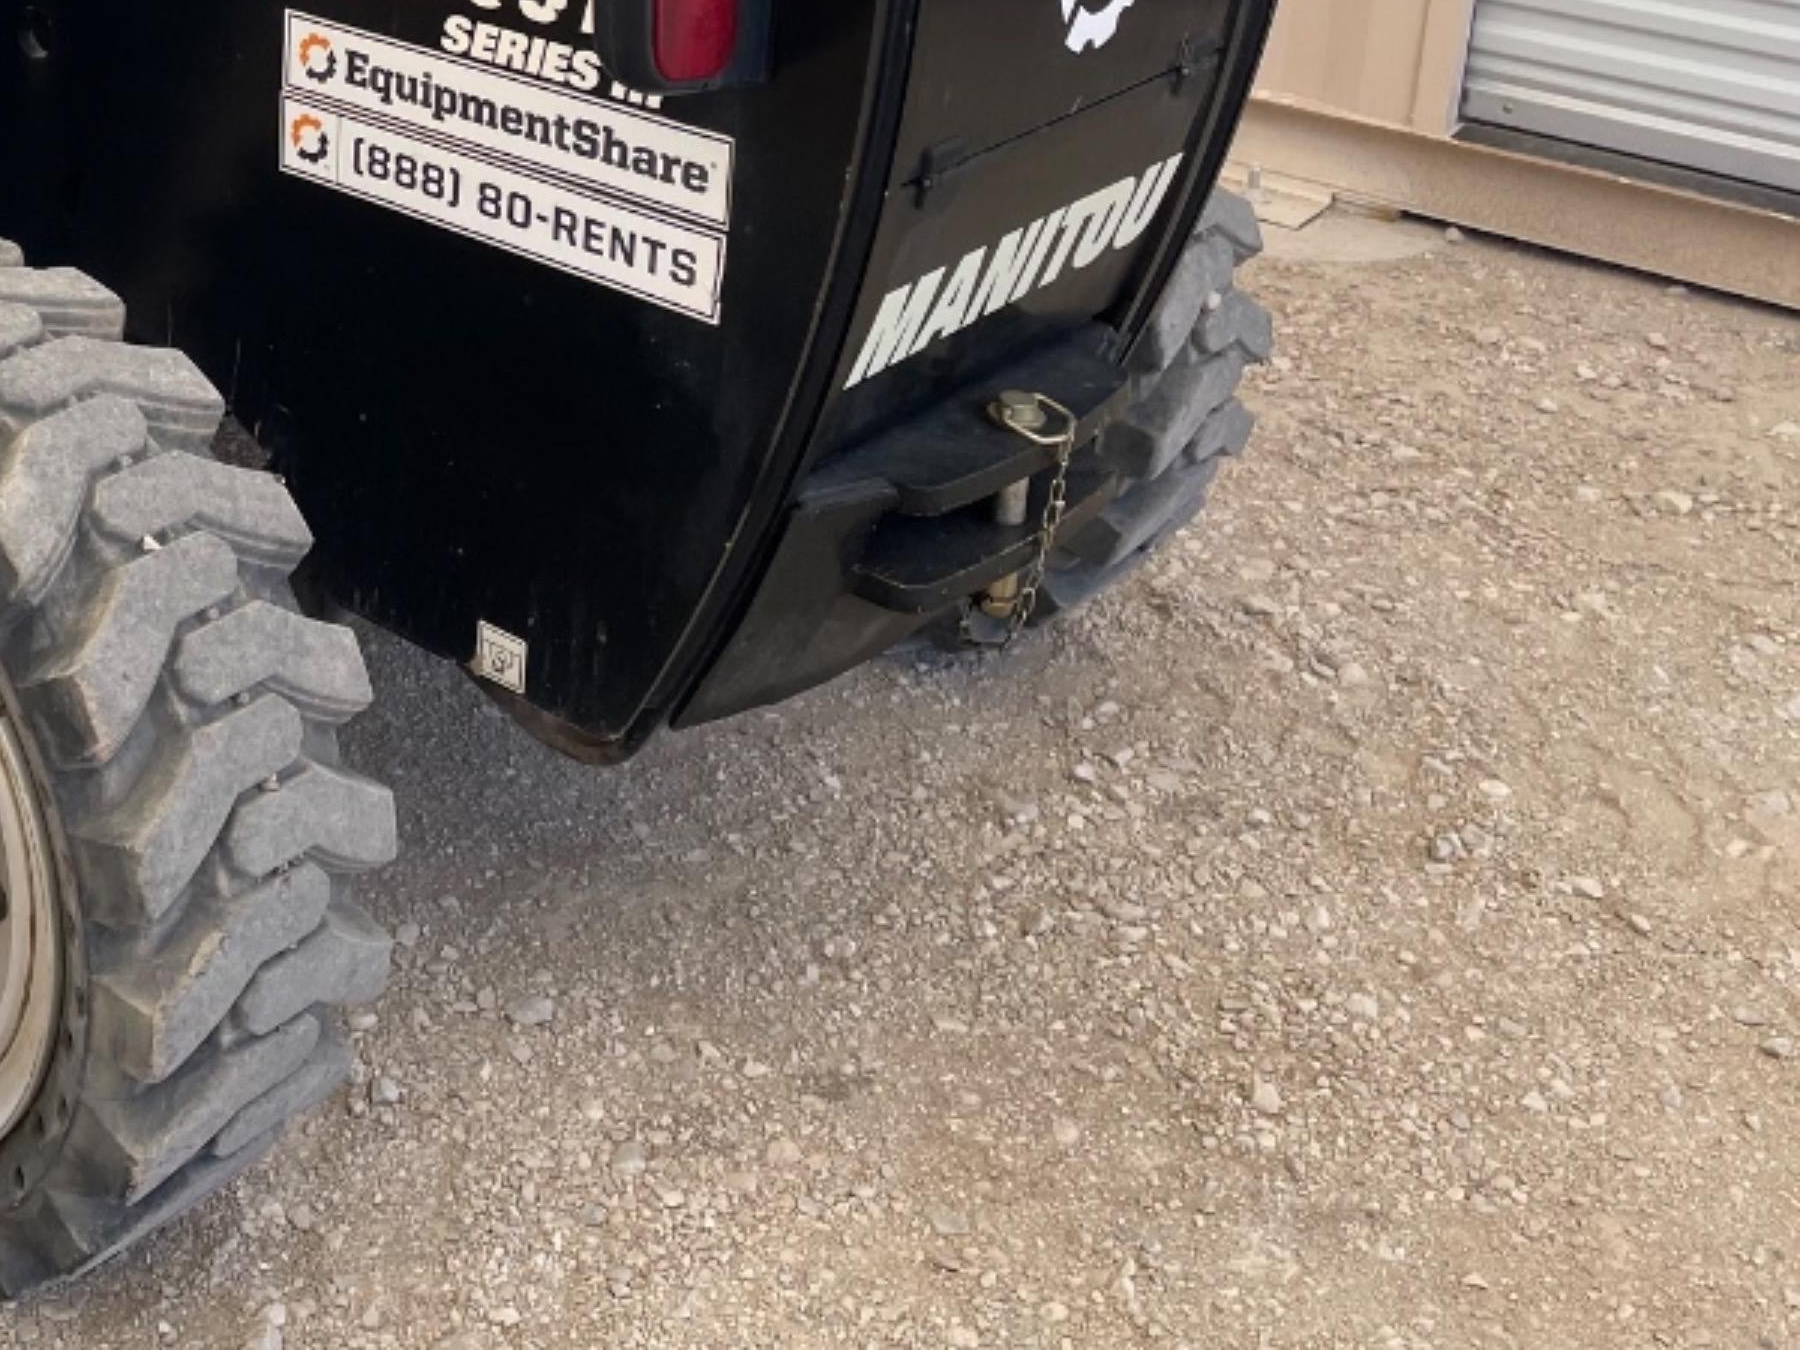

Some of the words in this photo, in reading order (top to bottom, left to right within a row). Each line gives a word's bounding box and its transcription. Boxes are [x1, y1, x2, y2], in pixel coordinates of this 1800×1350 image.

[344, 48, 709, 194] EquipmentShare
[440, 14, 602, 91] SERIES
[353, 136, 461, 208] (888)
[477, 181, 698, 288] 80-RENTS
[842, 152, 1184, 392] MANITOU
